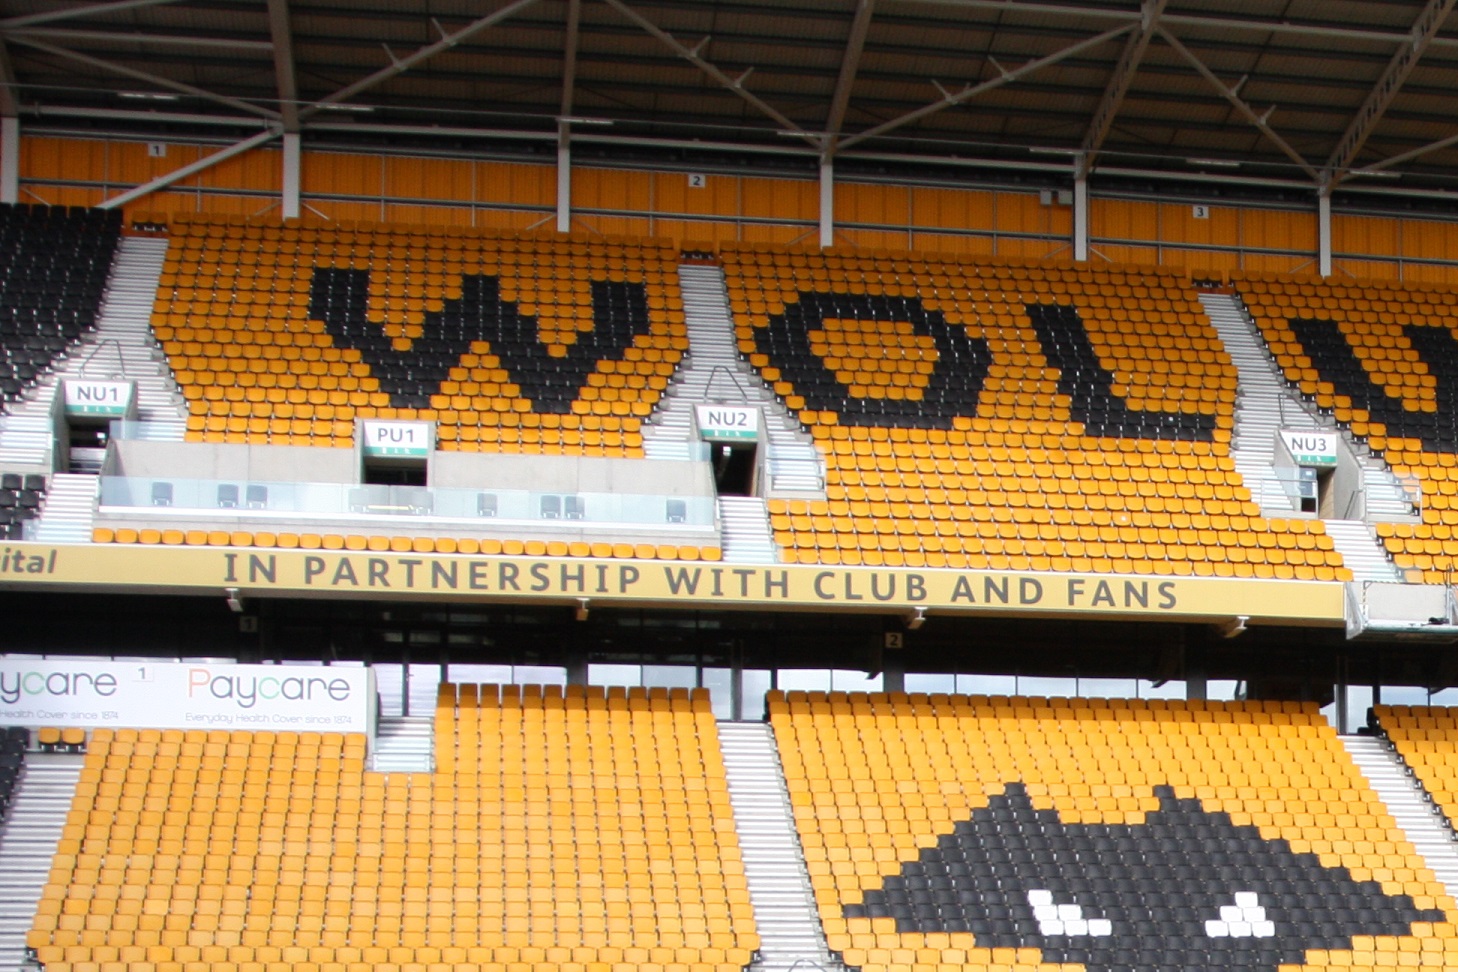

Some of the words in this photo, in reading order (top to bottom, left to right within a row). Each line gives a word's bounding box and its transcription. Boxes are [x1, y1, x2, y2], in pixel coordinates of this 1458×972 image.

[153, 145, 160, 155] 1
[693, 176, 701, 186] 2
[1197, 207, 1204, 217] 3
[77, 385, 118, 401] NU1
[708, 411, 748, 427] NU2
[377, 426, 414, 443] PU1
[1292, 438, 1327, 452] NU3
[224, 553, 277, 583] IN
[305, 556, 640, 593] PARTNERSHIP
[664, 566, 789, 598] WITH
[813, 571, 928, 601] CLUB
[950, 575, 1044, 605] AND
[1067, 578, 1177, 609] FANS
[890, 634, 898, 646] 2
[138, 667, 146, 679] 1
[188, 667, 351, 708] Paycare
[37, 710, 69, 719] Cover
[70, 711, 98, 720] since
[101, 712, 119, 720] 1874
[185, 712, 233, 724] Everyday
[236, 713, 269, 723] Health
[272, 714, 302, 723] Cover
[305, 715, 331, 724] since
[333, 716, 351, 724] 1874
